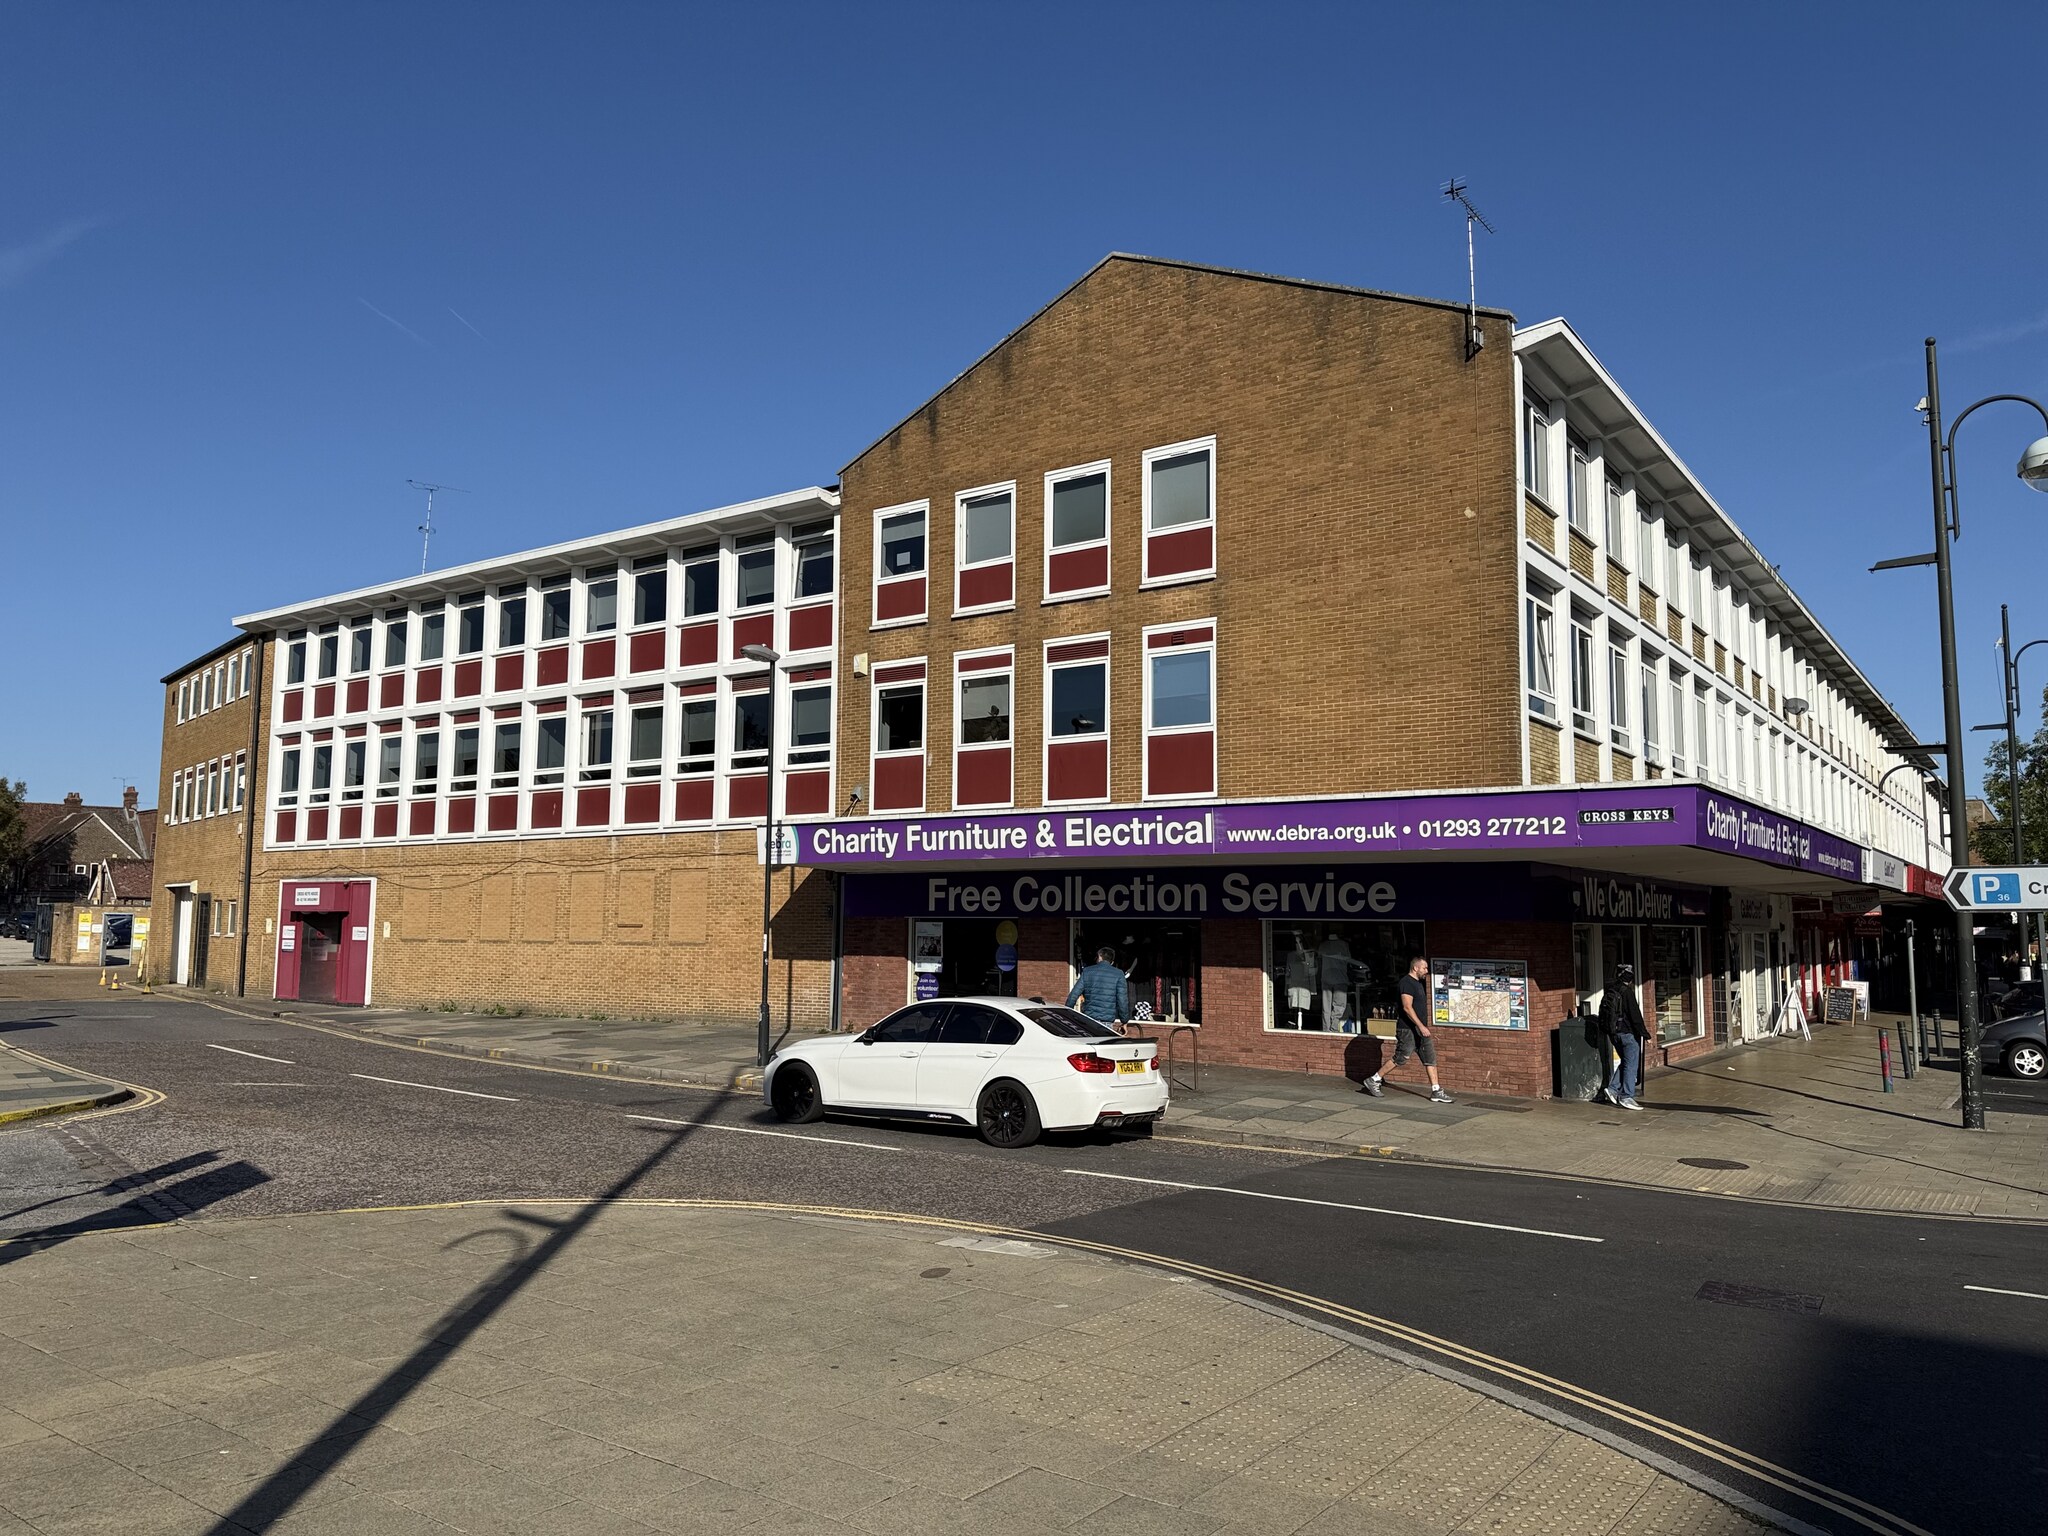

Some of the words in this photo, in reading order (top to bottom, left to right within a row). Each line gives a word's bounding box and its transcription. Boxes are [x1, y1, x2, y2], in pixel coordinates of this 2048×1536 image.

[1227, 822, 1397, 843] www.debra.org.uk
[1418, 819, 1482, 838] 01293
[1487, 816, 1567, 836] 277212
[1583, 811, 1626, 823] CROSS
[1632, 809, 1670, 821] KEYS
[1707, 799, 1741, 849] Charity
[1741, 811, 1775, 851] Furniture
[1776, 823, 1782, 853] &
[813, 826, 899, 858] Charity
[906, 823, 1027, 852] Furniture
[1035, 819, 1057, 848] &
[1065, 813, 1212, 847] Electrical
[928, 878, 1001, 912] Free
[1013, 875, 1207, 912] Collection
[1222, 872, 1397, 913] Service
[1583, 876, 1605, 916] We
[1608, 879, 1633, 918] Can
[1636, 882, 1672, 919] Deliver
[1979, 876, 2000, 901] P
[1997, 893, 2010, 901] 36
